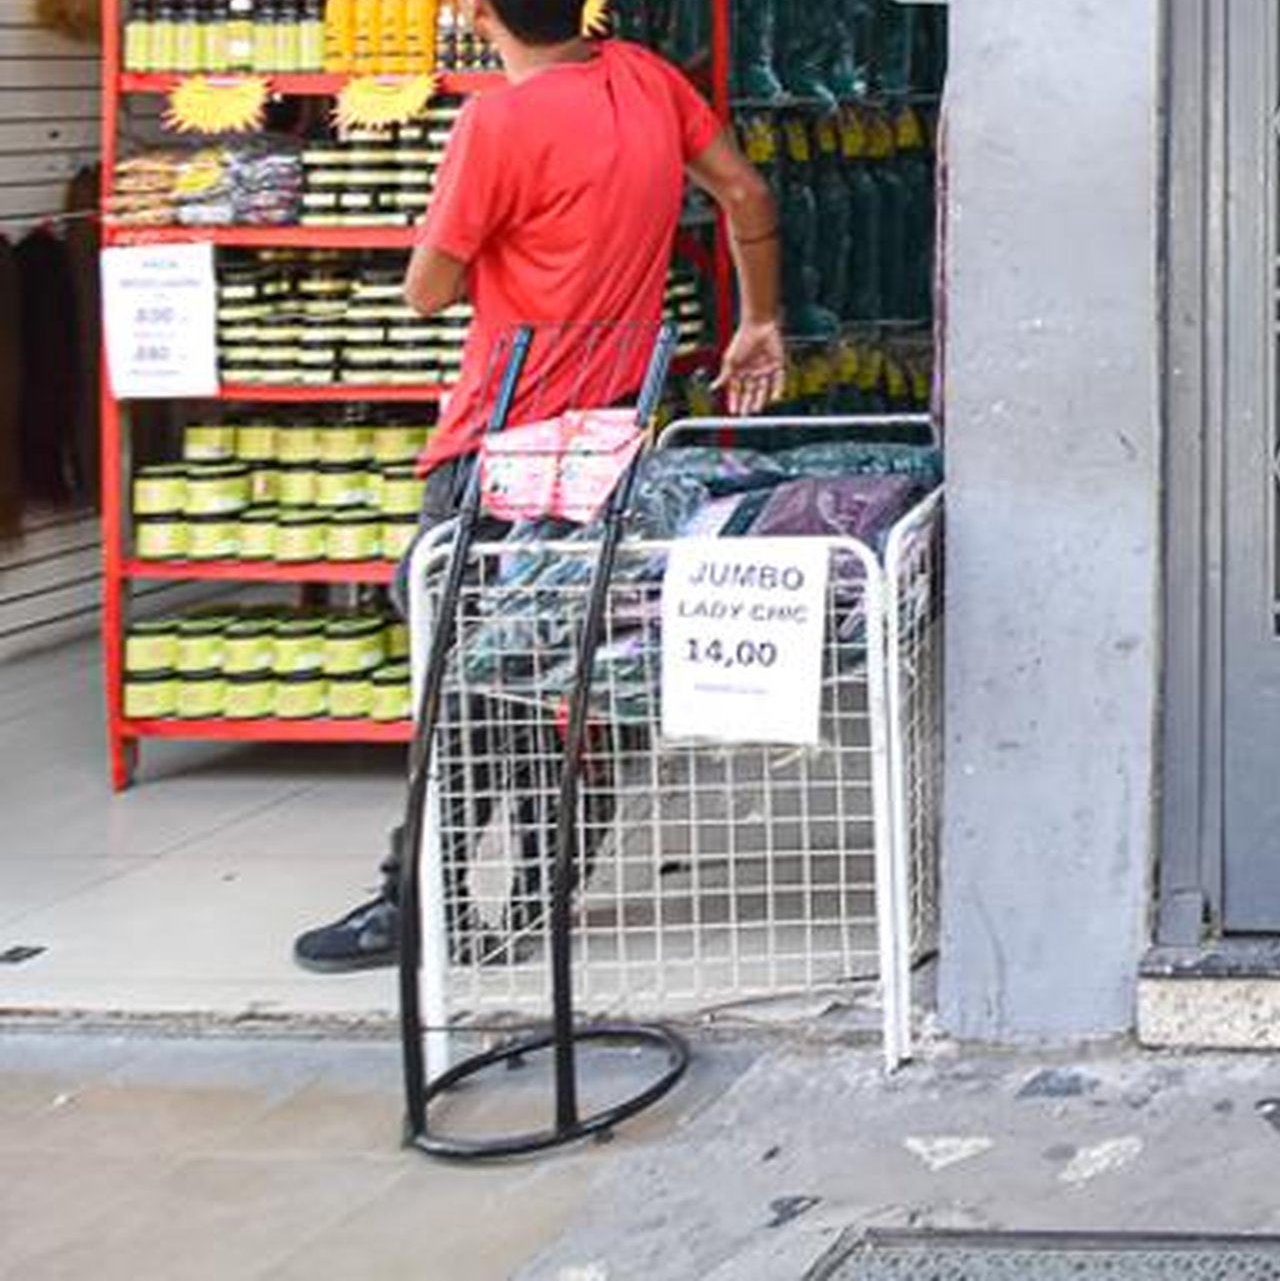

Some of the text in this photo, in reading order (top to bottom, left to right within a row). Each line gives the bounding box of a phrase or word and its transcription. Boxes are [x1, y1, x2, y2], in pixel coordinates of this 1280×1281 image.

[688, 561, 804, 591] JUMBO
[678, 599, 744, 619] LADY
[683, 637, 777, 668] 14,00
